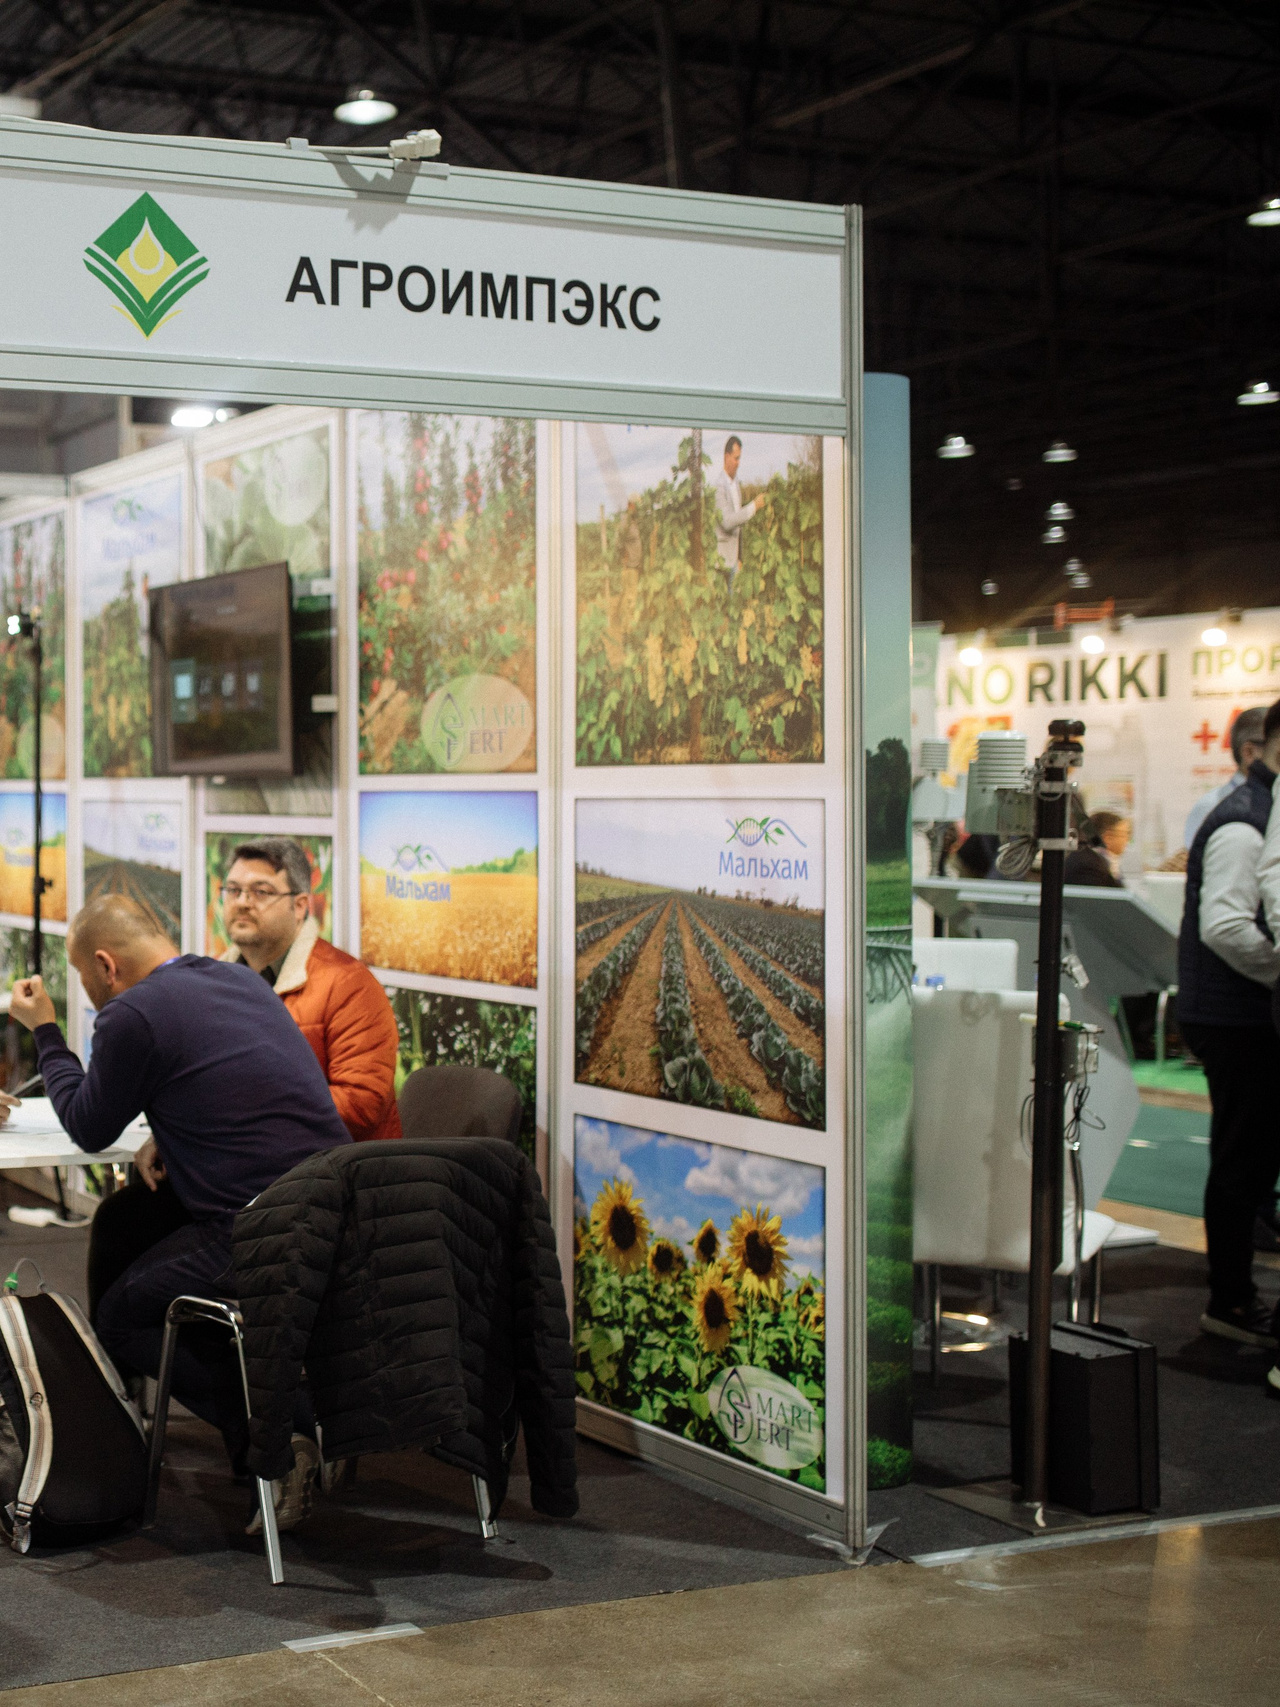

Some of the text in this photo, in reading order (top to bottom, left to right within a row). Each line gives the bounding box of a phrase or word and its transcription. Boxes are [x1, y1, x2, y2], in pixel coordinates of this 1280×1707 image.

[285, 256, 661, 333] АГРОИМПЭКС
[719, 851, 809, 880] Мальхам
[385, 874, 452, 904] Мальхам
